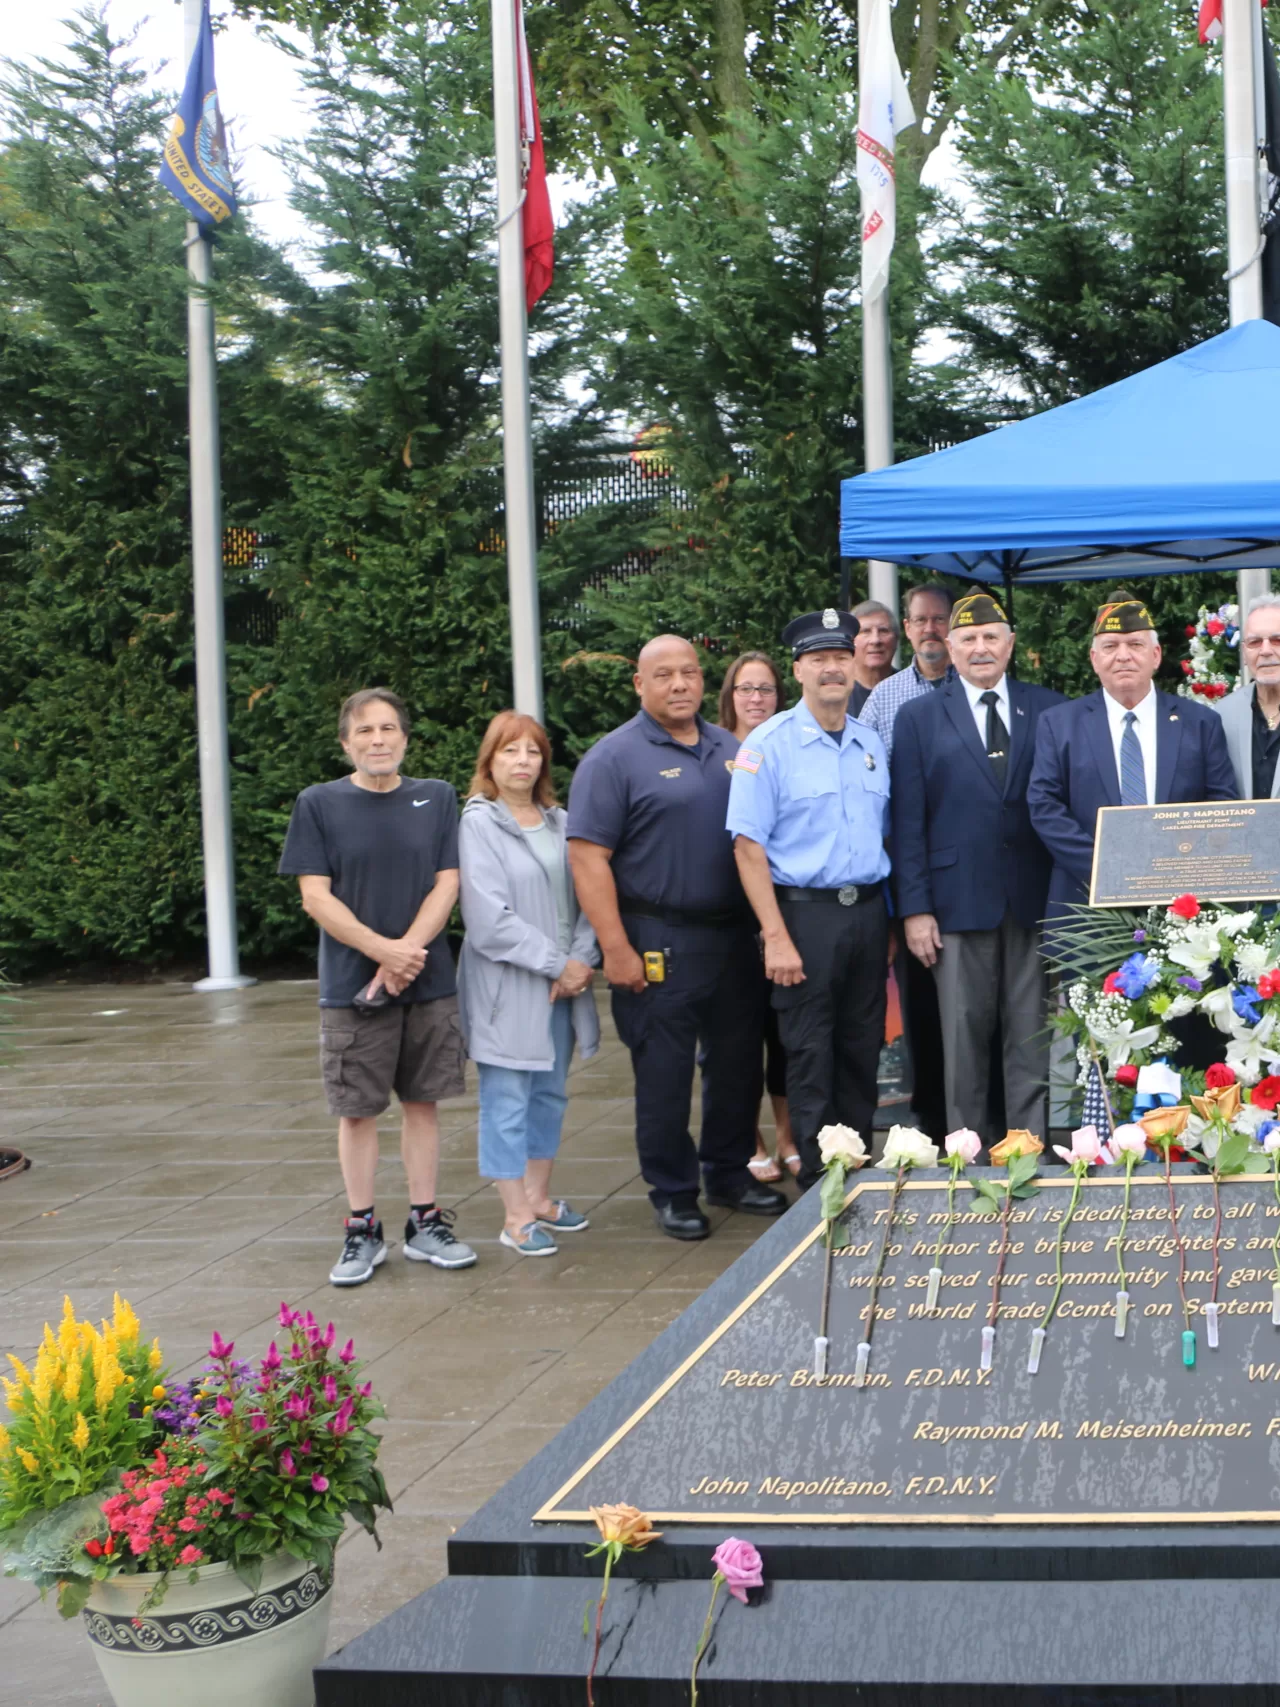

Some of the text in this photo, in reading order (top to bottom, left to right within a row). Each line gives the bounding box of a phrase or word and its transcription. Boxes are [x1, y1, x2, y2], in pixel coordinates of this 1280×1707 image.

[166, 142, 224, 214] UNITED STATES
[1152, 812, 1180, 820] JOHN
[1194, 808, 1256, 818] NAPOLITANO
[872, 1208, 918, 1226] This
[926, 1207, 1037, 1225] memorial
[1042, 1206, 1063, 1222] is
[1072, 1205, 1184, 1222] dedicated
[1192, 1206, 1215, 1220] to
[1225, 1202, 1254, 1218] all
[911, 1240, 980, 1256] honor
[987, 1239, 1024, 1254] the
[1034, 1238, 1094, 1254] brave
[1104, 1236, 1236, 1258] Firefighters
[904, 1270, 981, 1288] seved
[987, 1273, 1028, 1286] our
[1035, 1266, 1168, 1288] community
[1176, 1266, 1222, 1283] and
[1226, 1268, 1280, 1288] gave
[859, 1304, 897, 1320] the
[908, 1302, 976, 1320] World
[985, 1302, 1046, 1320] Trade
[1144, 1302, 1173, 1316] on
[720, 1368, 782, 1388] Peter
[904, 1368, 992, 1386] F.D.N.Y.
[913, 1422, 1028, 1445] Raymond
[1033, 1422, 1064, 1440] M.
[1075, 1418, 1252, 1440] Meisenheimer,
[690, 1476, 996, 1500] John Napolitano, F.D.N.Y.
